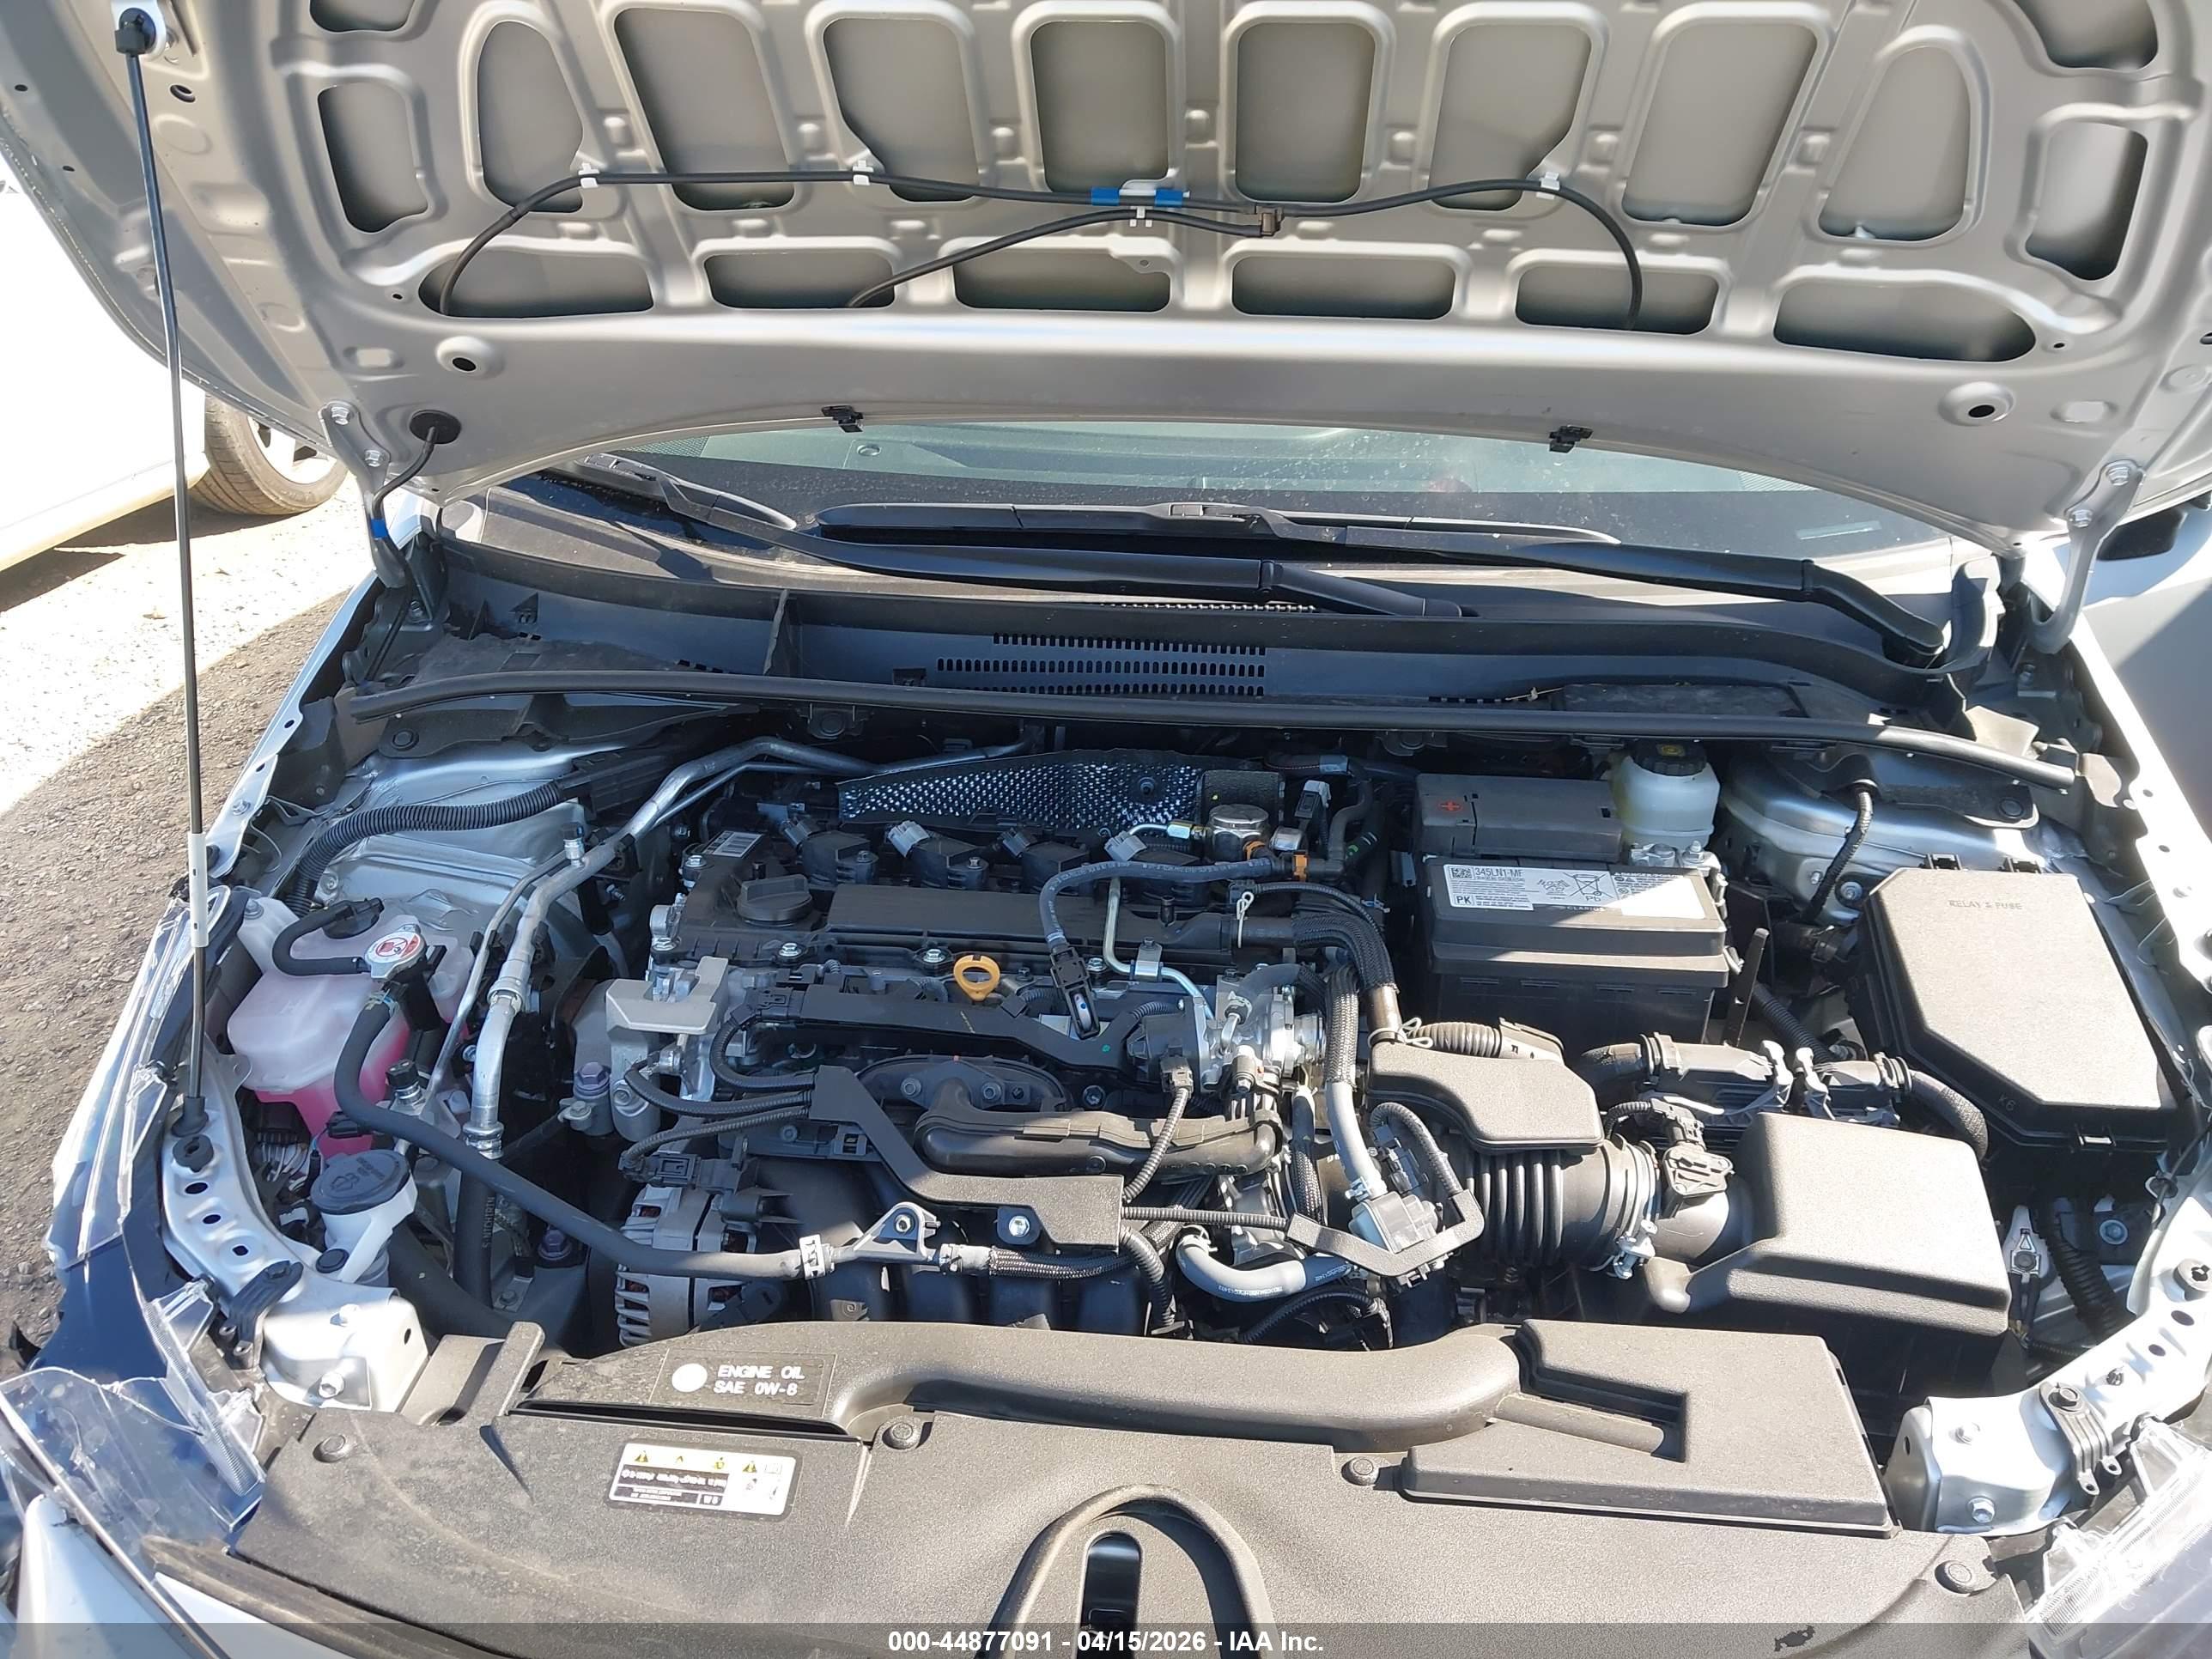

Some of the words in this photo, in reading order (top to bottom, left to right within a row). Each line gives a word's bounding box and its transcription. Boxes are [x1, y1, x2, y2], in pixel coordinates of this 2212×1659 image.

[1456, 896, 1471, 904] PK
[1948, 899, 1980, 908] RELAY
[1995, 902, 2023, 910] FUSE
[718, 1364, 774, 1379] ENGINE
[781, 1365, 805, 1380] OIL
[714, 1380, 746, 1395] SAE
[755, 1382, 798, 1396] 0W-8
